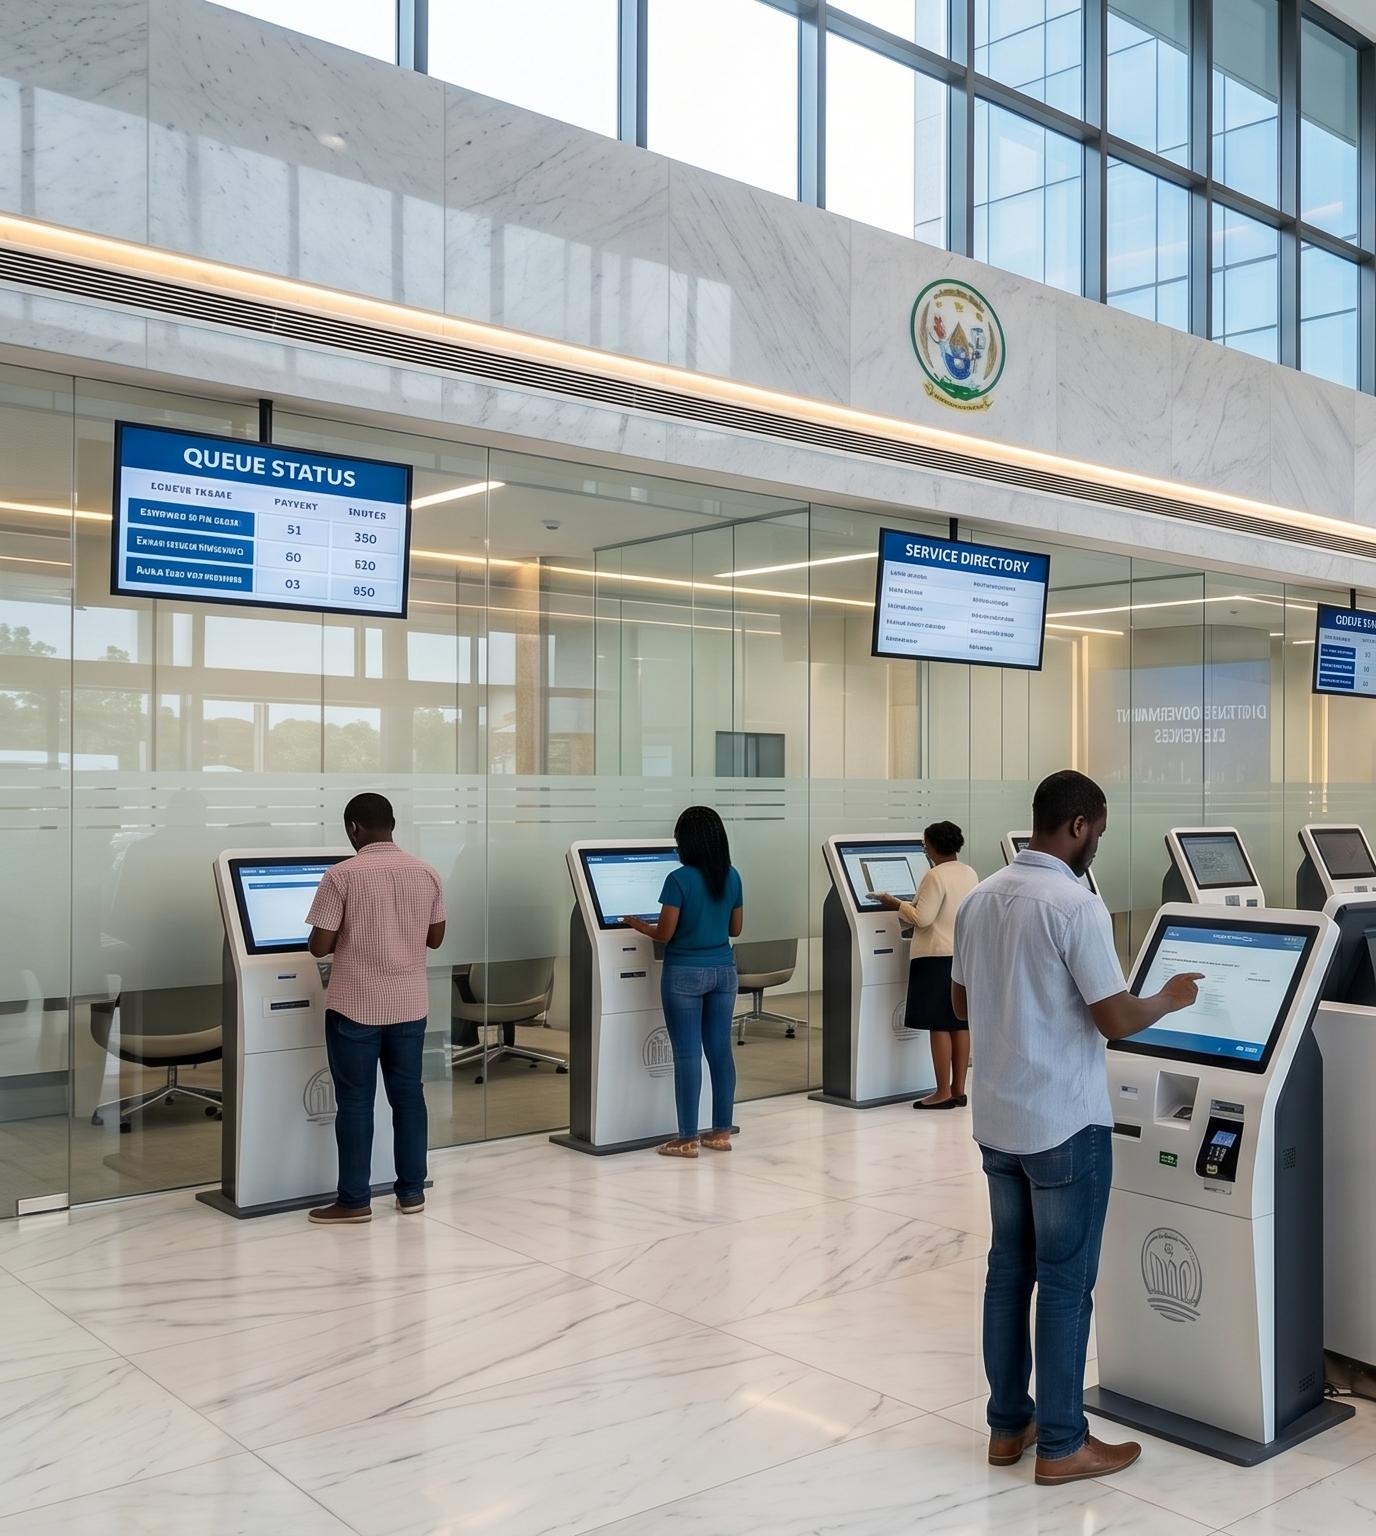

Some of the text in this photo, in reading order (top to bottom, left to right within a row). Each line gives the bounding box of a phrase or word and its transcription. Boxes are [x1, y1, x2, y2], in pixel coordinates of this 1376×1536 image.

[184, 447, 356, 488] QUEUE STATUS
[354, 532, 377, 544] 350
[905, 543, 1030, 573] SERVICE DIRECTORY
